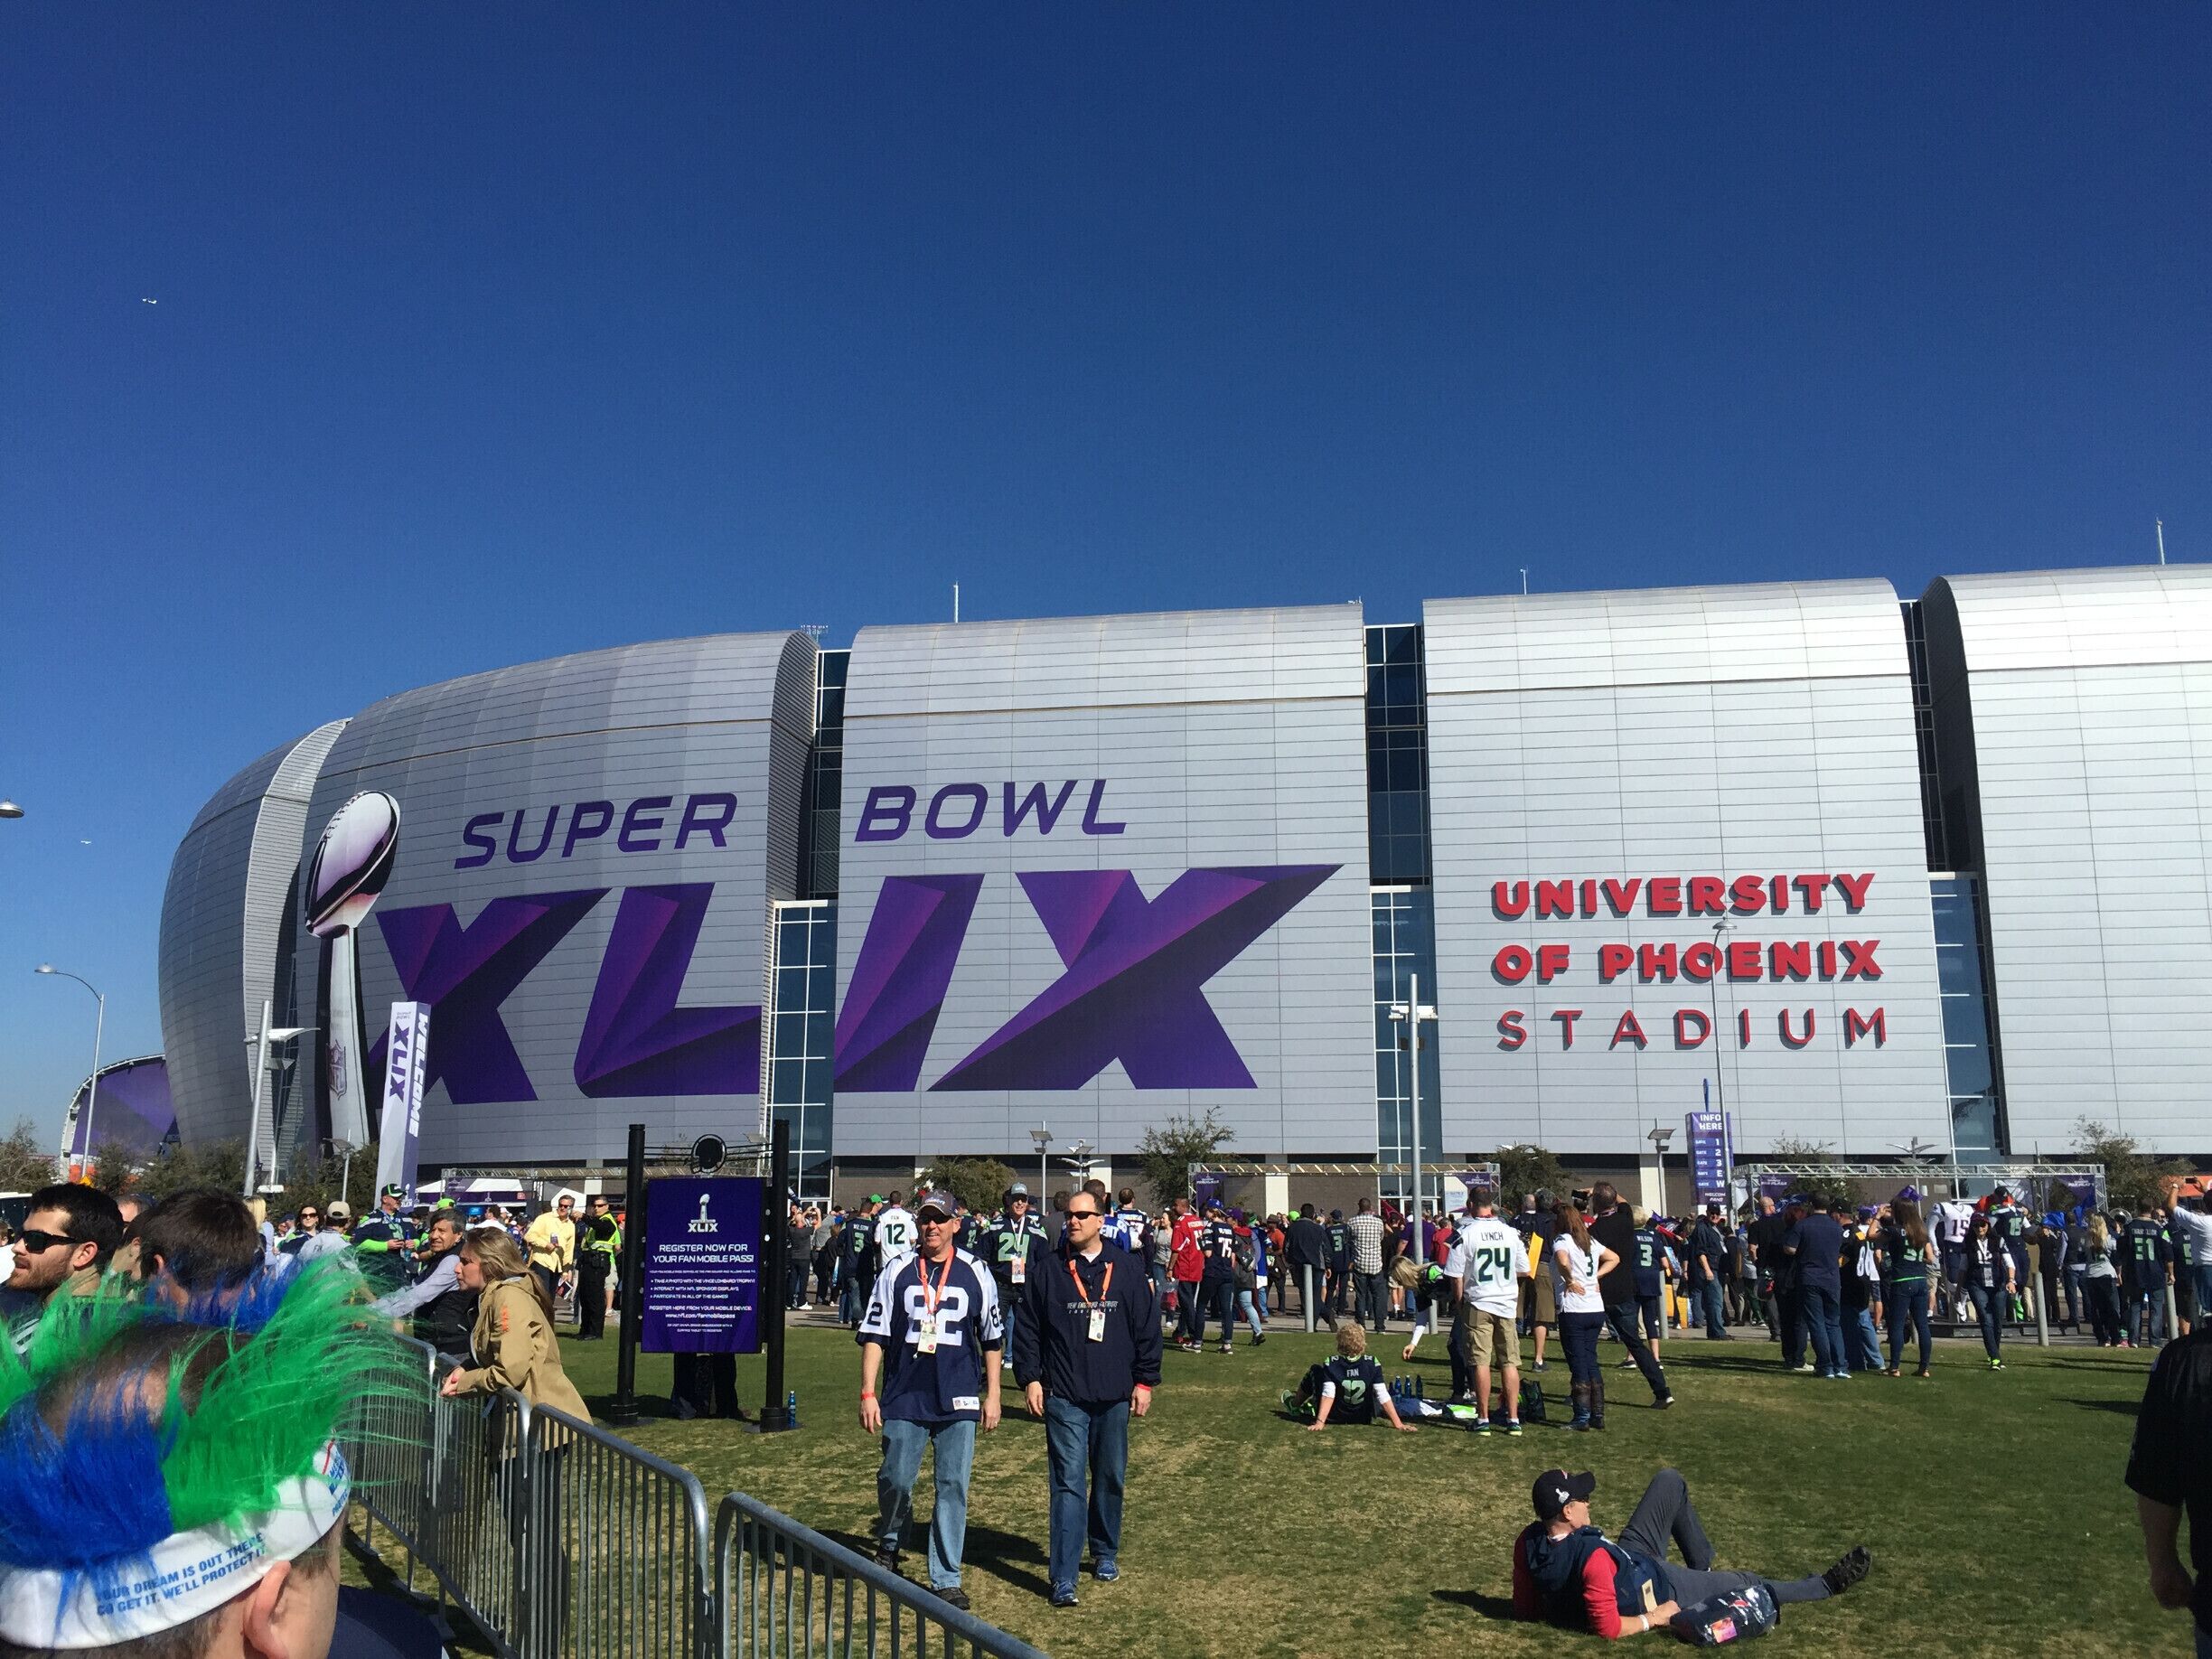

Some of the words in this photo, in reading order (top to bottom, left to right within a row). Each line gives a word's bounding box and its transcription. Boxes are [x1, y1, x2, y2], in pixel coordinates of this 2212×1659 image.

[455, 792, 738, 869] SUPER
[855, 779, 1128, 842] BOWL
[1493, 873, 1876, 916] UNIVERSITY
[1494, 943, 1570, 981] OF
[1602, 940, 1884, 979] PHOENIX
[369, 864, 1345, 1105] XLIX
[1499, 1008, 1888, 1046] STADIUM
[389, 1021, 410, 1103] XLIX
[408, 1012, 429, 1138] WELCOME
[1699, 1122, 1723, 1130] HERE
[1700, 1113, 1722, 1121] INFO
[1716, 1180, 1725, 1188] W
[687, 1223, 719, 1233] XLIX
[885, 1223, 905, 1245] 12
[1481, 1232, 1504, 1242] LYNCH
[1952, 1219, 1969, 1237] 15
[659, 1244, 703, 1252] REGISTER
[705, 1244, 727, 1252] NOW
[728, 1243, 748, 1252] FOR
[854, 1232, 865, 1252] 3
[998, 1232, 1030, 1263] 24
[1333, 1235, 1343, 1251] 3
[652, 1255, 677, 1263] YOUR
[678, 1255, 696, 1263] FAN
[696, 1255, 728, 1263] MOBILE
[1476, 1247, 1511, 1283] 24
[1640, 1243, 1653, 1267] 3
[867, 1302, 883, 1327] 2
[904, 1284, 970, 1346] 82
[1346, 1368, 1359, 1378] FAN
[1341, 1379, 1366, 1405] 12
[134, 1571, 180, 1594] DREAM
[183, 1565, 196, 1579] IS
[198, 1553, 223, 1572] OUT
[162, 1582, 200, 1600] WE'LL
[201, 1553, 254, 1585] PROTECT
